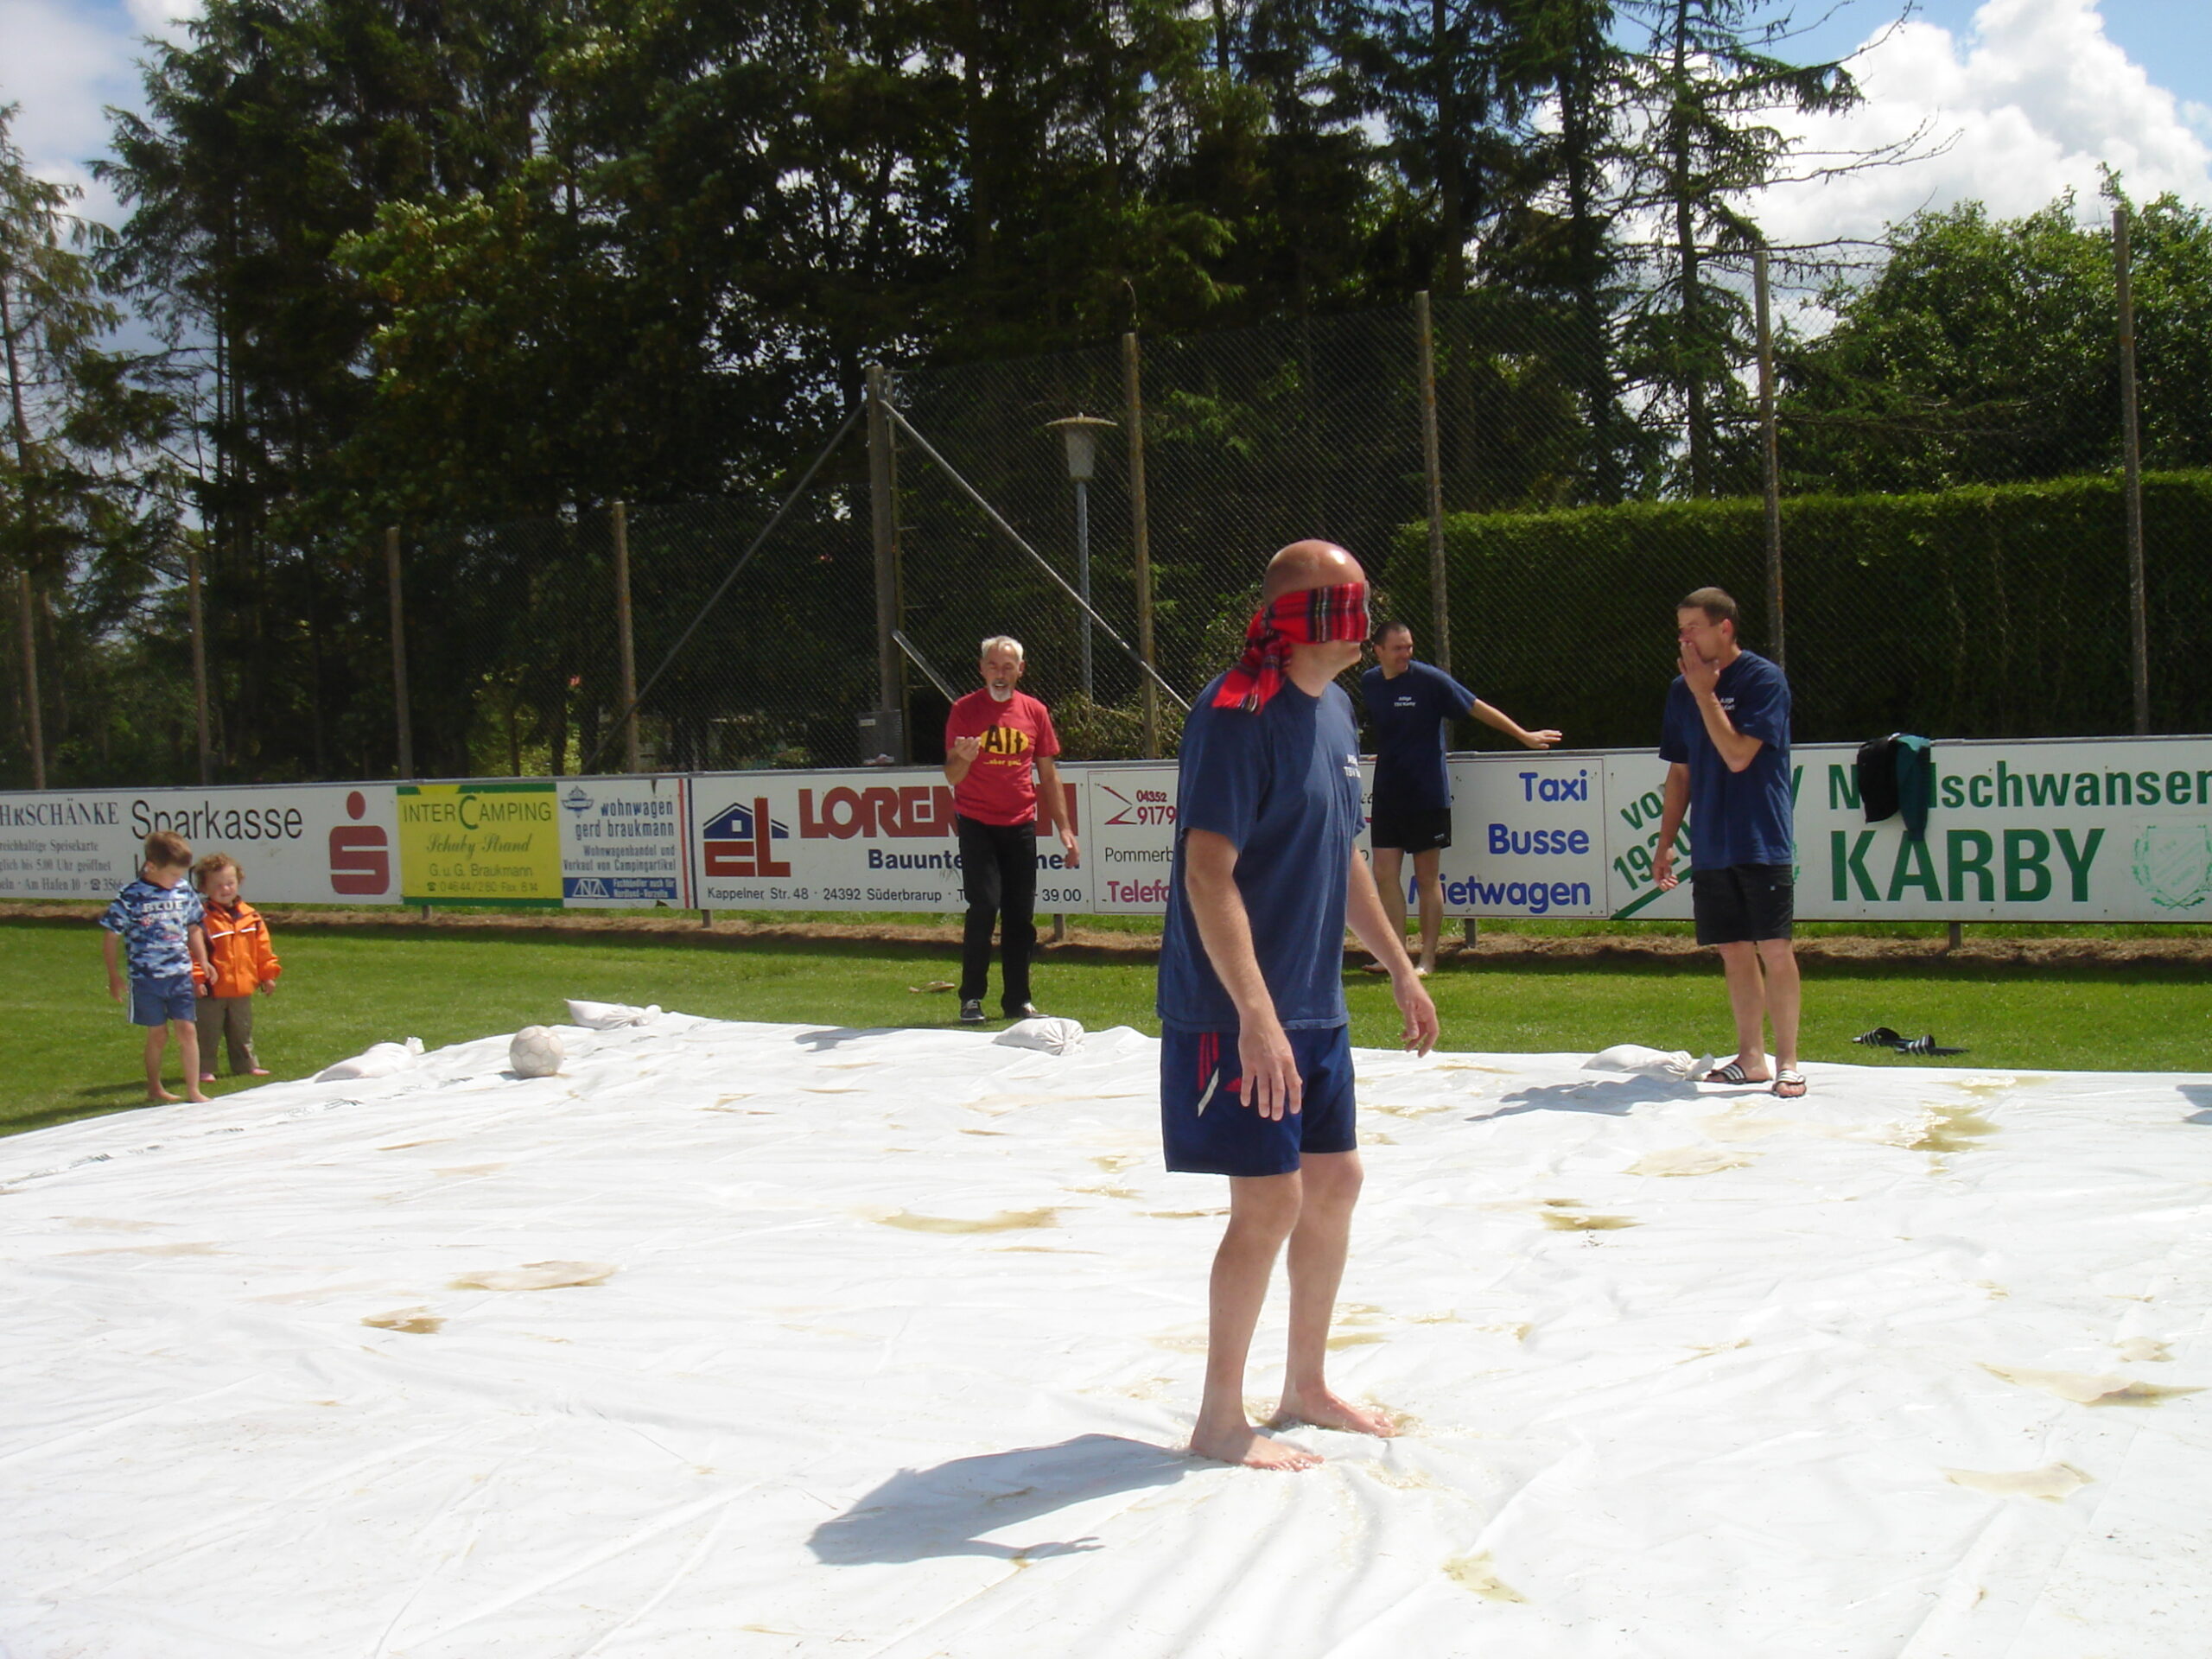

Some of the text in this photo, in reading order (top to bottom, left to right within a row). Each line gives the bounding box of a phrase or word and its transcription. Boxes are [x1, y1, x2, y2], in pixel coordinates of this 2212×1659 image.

[984, 724, 1024, 754] Alt
[1136, 790, 1167, 802] 04352
[1519, 769, 1588, 802] Taxi
[1828, 760, 2212, 810] Nschwansen
[601, 798, 674, 819] wohnwagen
[1620, 783, 1666, 830] vo
[131, 799, 303, 840] Sparkasse
[575, 819, 675, 841] gerd braukmann
[50, 839, 99, 854] Speisekarte
[1488, 823, 1590, 855] Busse
[583, 844, 676, 858] Wohnwagenhandel und
[57, 859, 73, 871] Uhr
[78, 859, 111, 873] geöffnet
[563, 859, 677, 873] Verkauf von Campingartikel
[1831, 828, 2106, 903] KARBY
[41, 877, 69, 891] Hafen
[708, 887, 765, 900] Kappelner
[770, 887, 790, 899] Str.
[793, 887, 809, 899] 48
[823, 887, 861, 900] 24392
[867, 887, 943, 902] Süderbrarup
[1408, 874, 1591, 913] ietwagen
